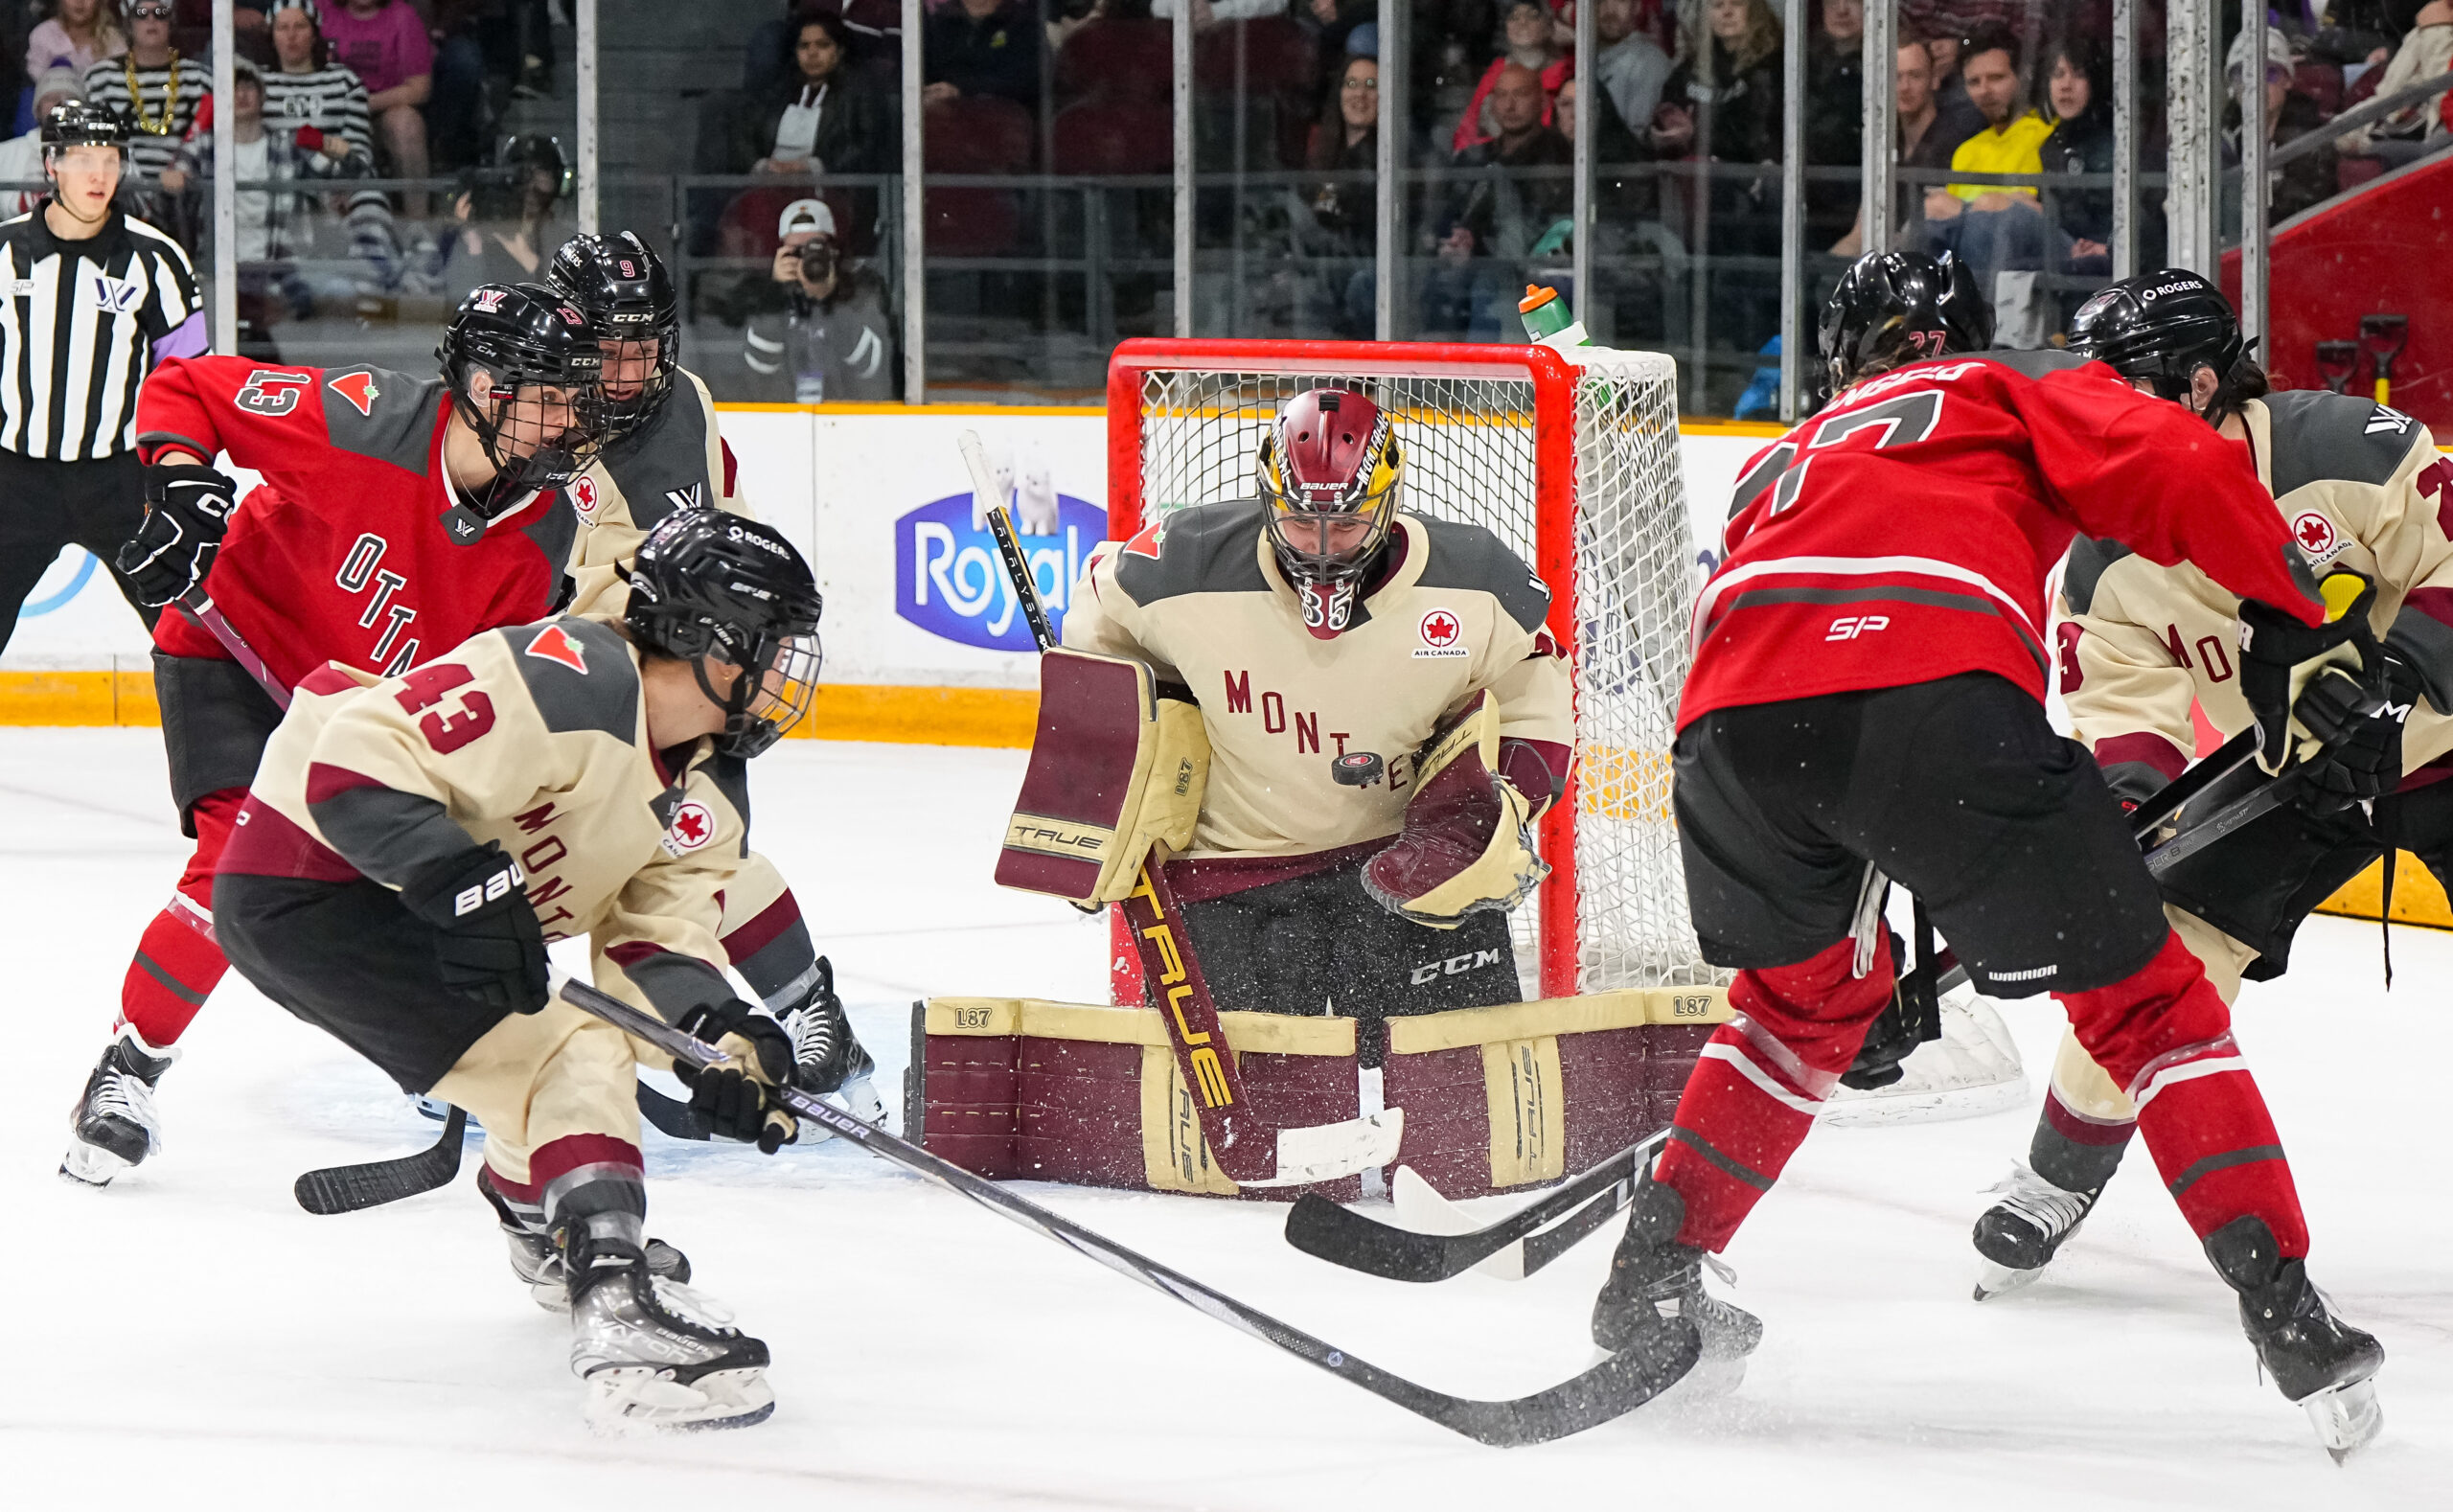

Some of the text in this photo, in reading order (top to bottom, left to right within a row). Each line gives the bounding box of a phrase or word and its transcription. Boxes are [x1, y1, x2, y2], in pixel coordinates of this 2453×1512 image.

[619, 260, 635, 278] 9
[2156, 280, 2203, 297] ROGERS
[556, 308, 583, 325] 13
[611, 312, 655, 324] CCM
[570, 356, 601, 367] CCM
[233, 369, 312, 417] 13
[1299, 482, 1350, 491] BAUER
[745, 531, 791, 561] ROGERS
[2320, 540, 2353, 563] CANADA
[914, 520, 1089, 638] Royal
[989, 511, 1042, 626] CATALYST
[1297, 584, 1353, 631] 35
[1824, 615, 1891, 642] SP
[393, 662, 496, 755] 43
[1224, 670, 1409, 792] MONTE
[1174, 756, 1194, 797] L87
[1014, 825, 1105, 851] TRUE
[1410, 948, 1501, 986] CCM
[1988, 964, 2058, 982] WARRIOR
[1129, 864, 1234, 1110] TRUE
[954, 1007, 993, 1029] L87
[1673, 995, 1713, 1018] L87
[1520, 1044, 1538, 1174] TRUE
